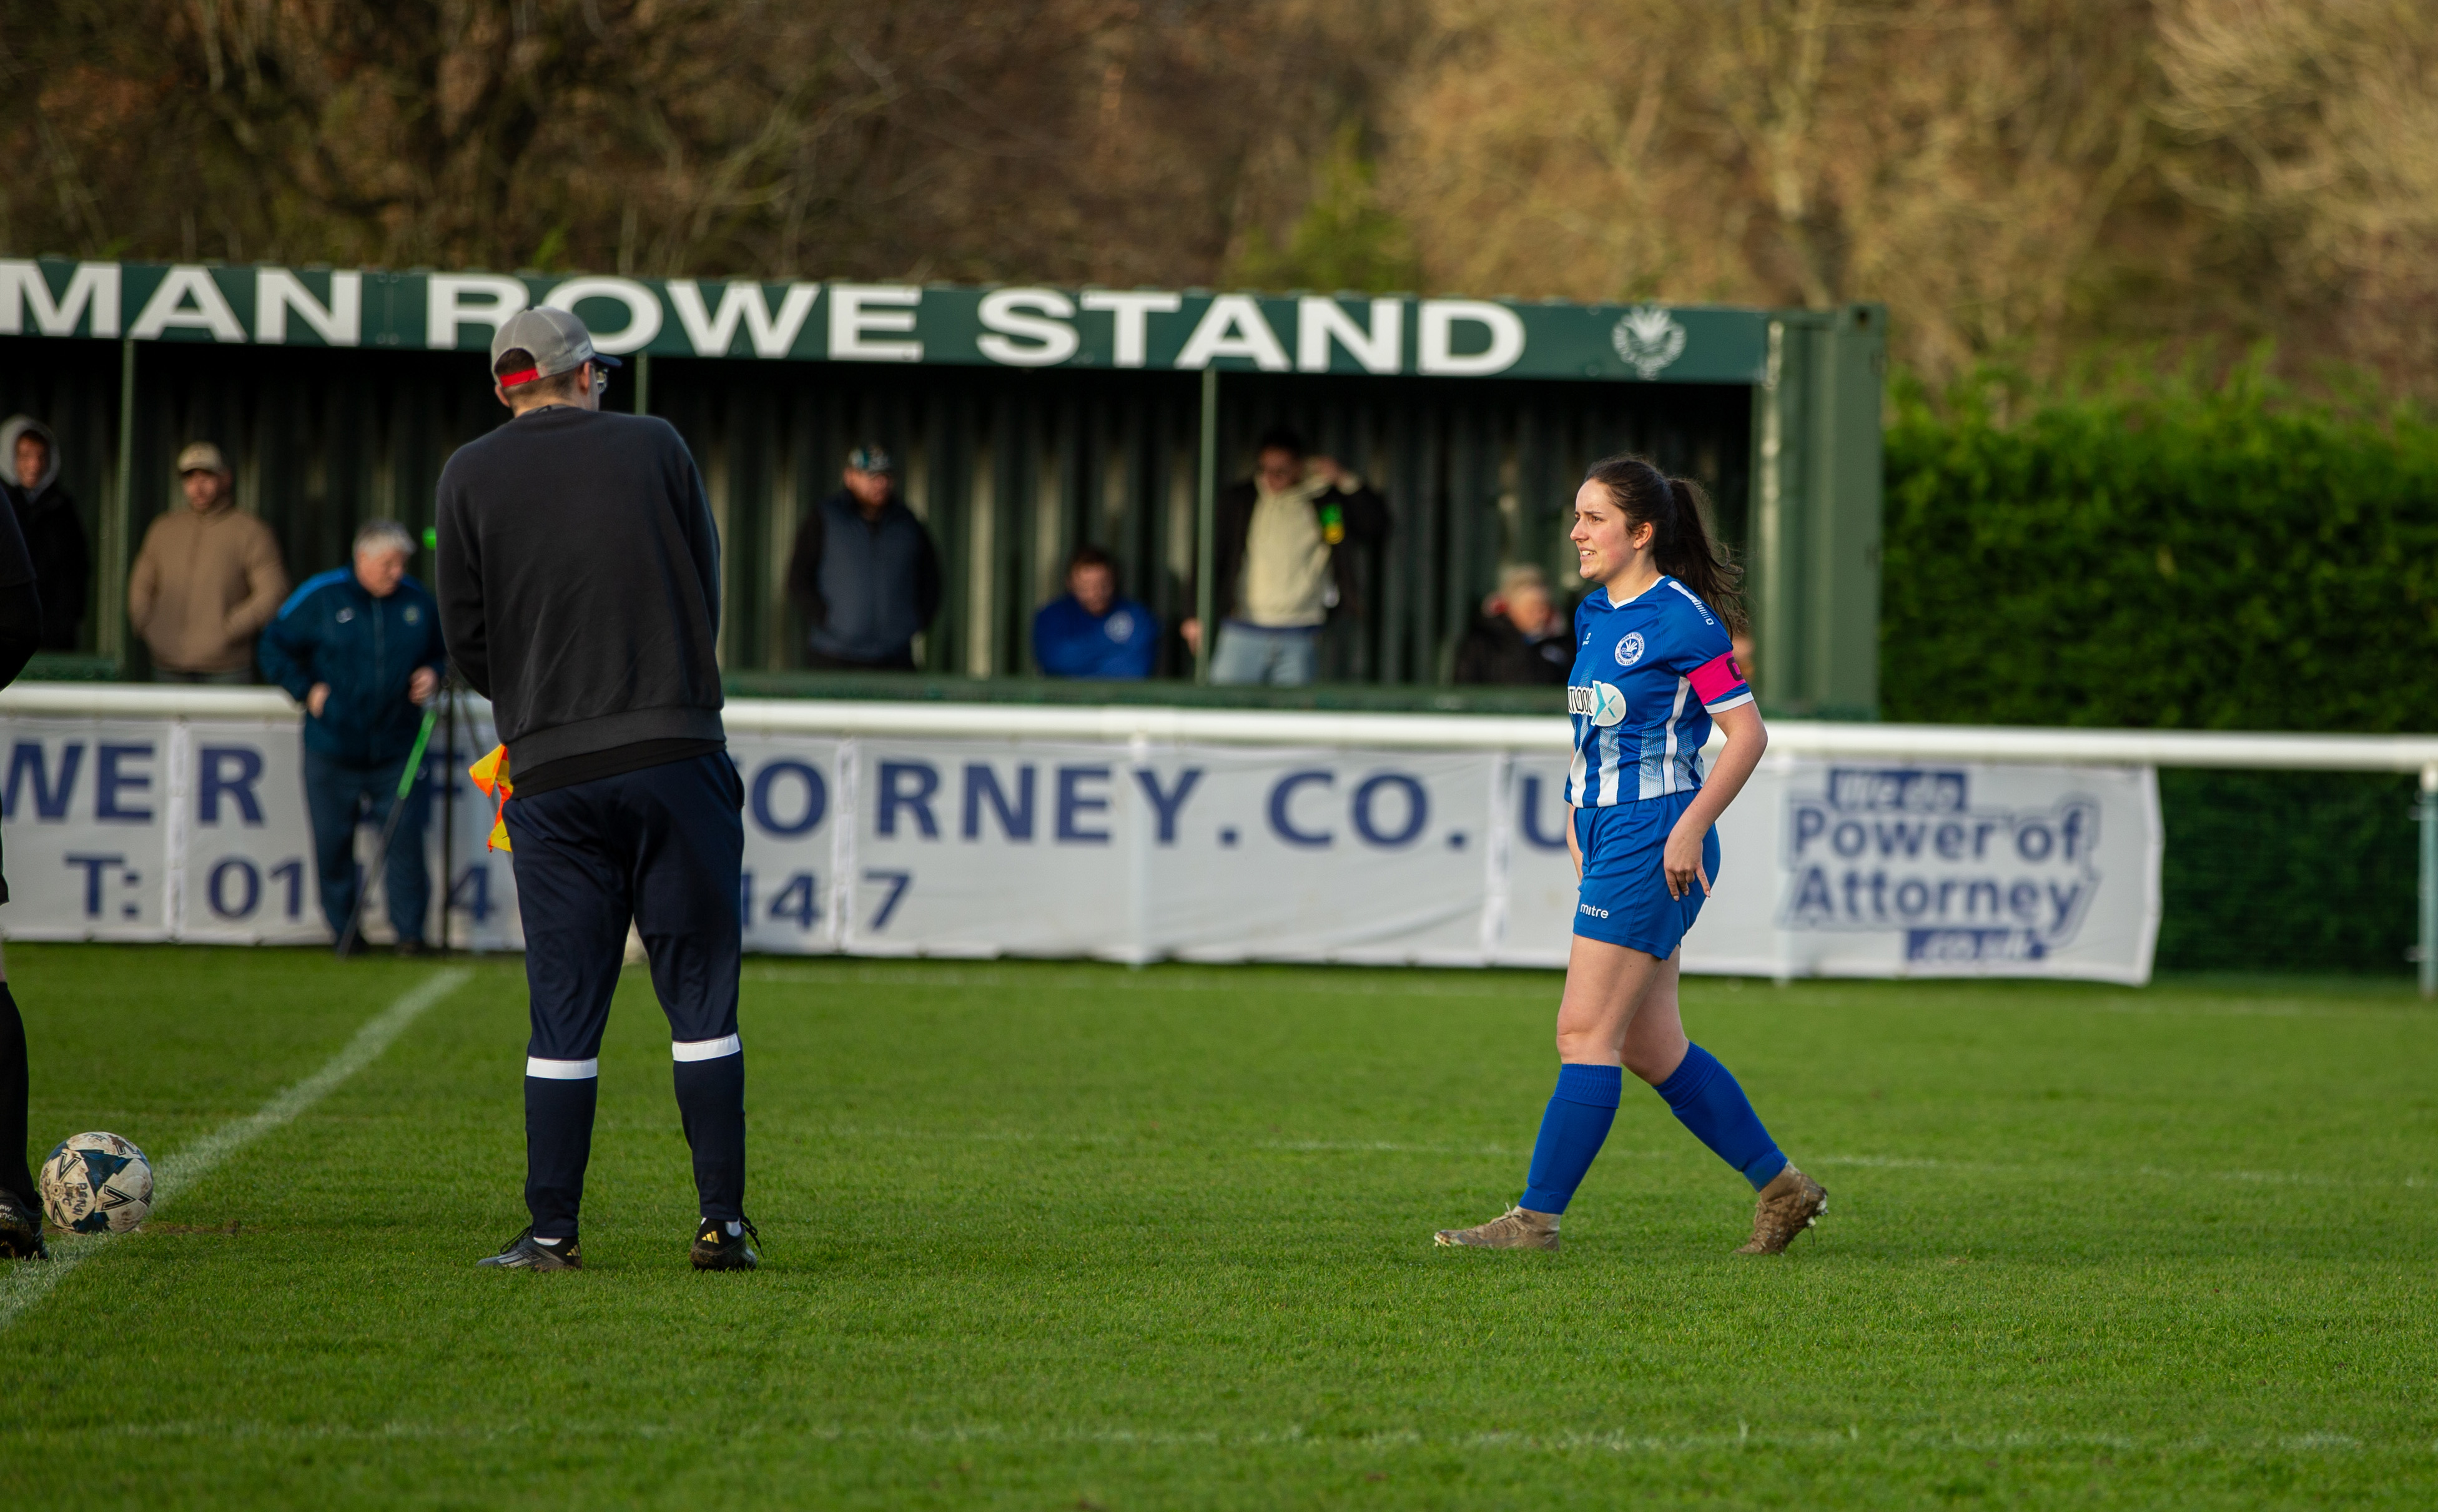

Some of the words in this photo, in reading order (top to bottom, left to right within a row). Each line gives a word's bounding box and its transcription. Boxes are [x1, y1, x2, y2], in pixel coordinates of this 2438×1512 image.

[0, 259, 362, 347] MAN
[427, 273, 922, 361] ROWE
[977, 287, 1525, 375] STAND
[0, 739, 265, 828] WER
[1795, 809, 1996, 859] Power
[2016, 809, 2084, 861] of
[65, 852, 141, 921] T:
[1580, 904, 1609, 919] mitre
[1795, 868, 2082, 936] Attorney
